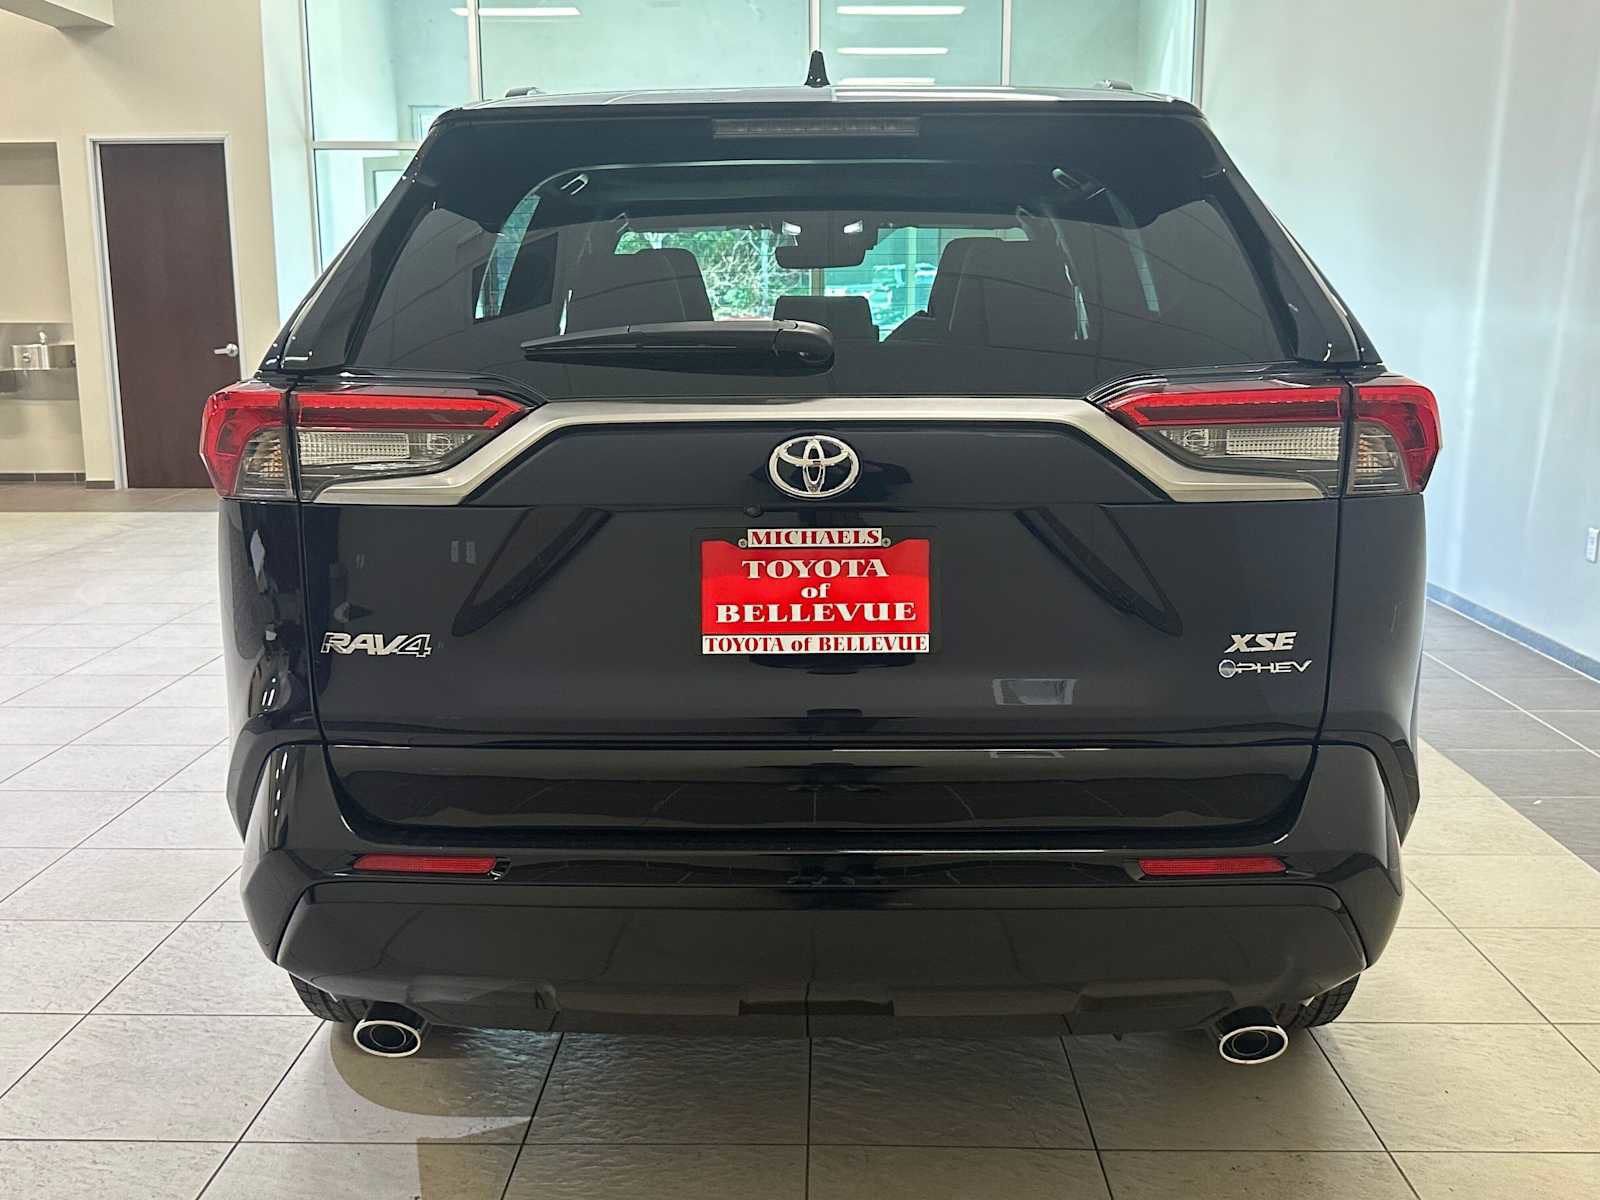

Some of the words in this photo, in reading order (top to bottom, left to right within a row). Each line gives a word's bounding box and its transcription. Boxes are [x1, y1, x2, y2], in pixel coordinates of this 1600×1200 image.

[750, 529, 880, 546] MICHAELS
[742, 558, 890, 579] TOYOTA
[800, 582, 831, 598] of
[715, 602, 917, 624] BELLEVUE
[320, 631, 432, 658] RAV4
[705, 637, 785, 652] TOYOTA
[791, 637, 813, 652] of
[819, 635, 928, 652] BELLEVUE
[1223, 631, 1298, 654] XSE
[1236, 659, 1313, 674] PHEV
